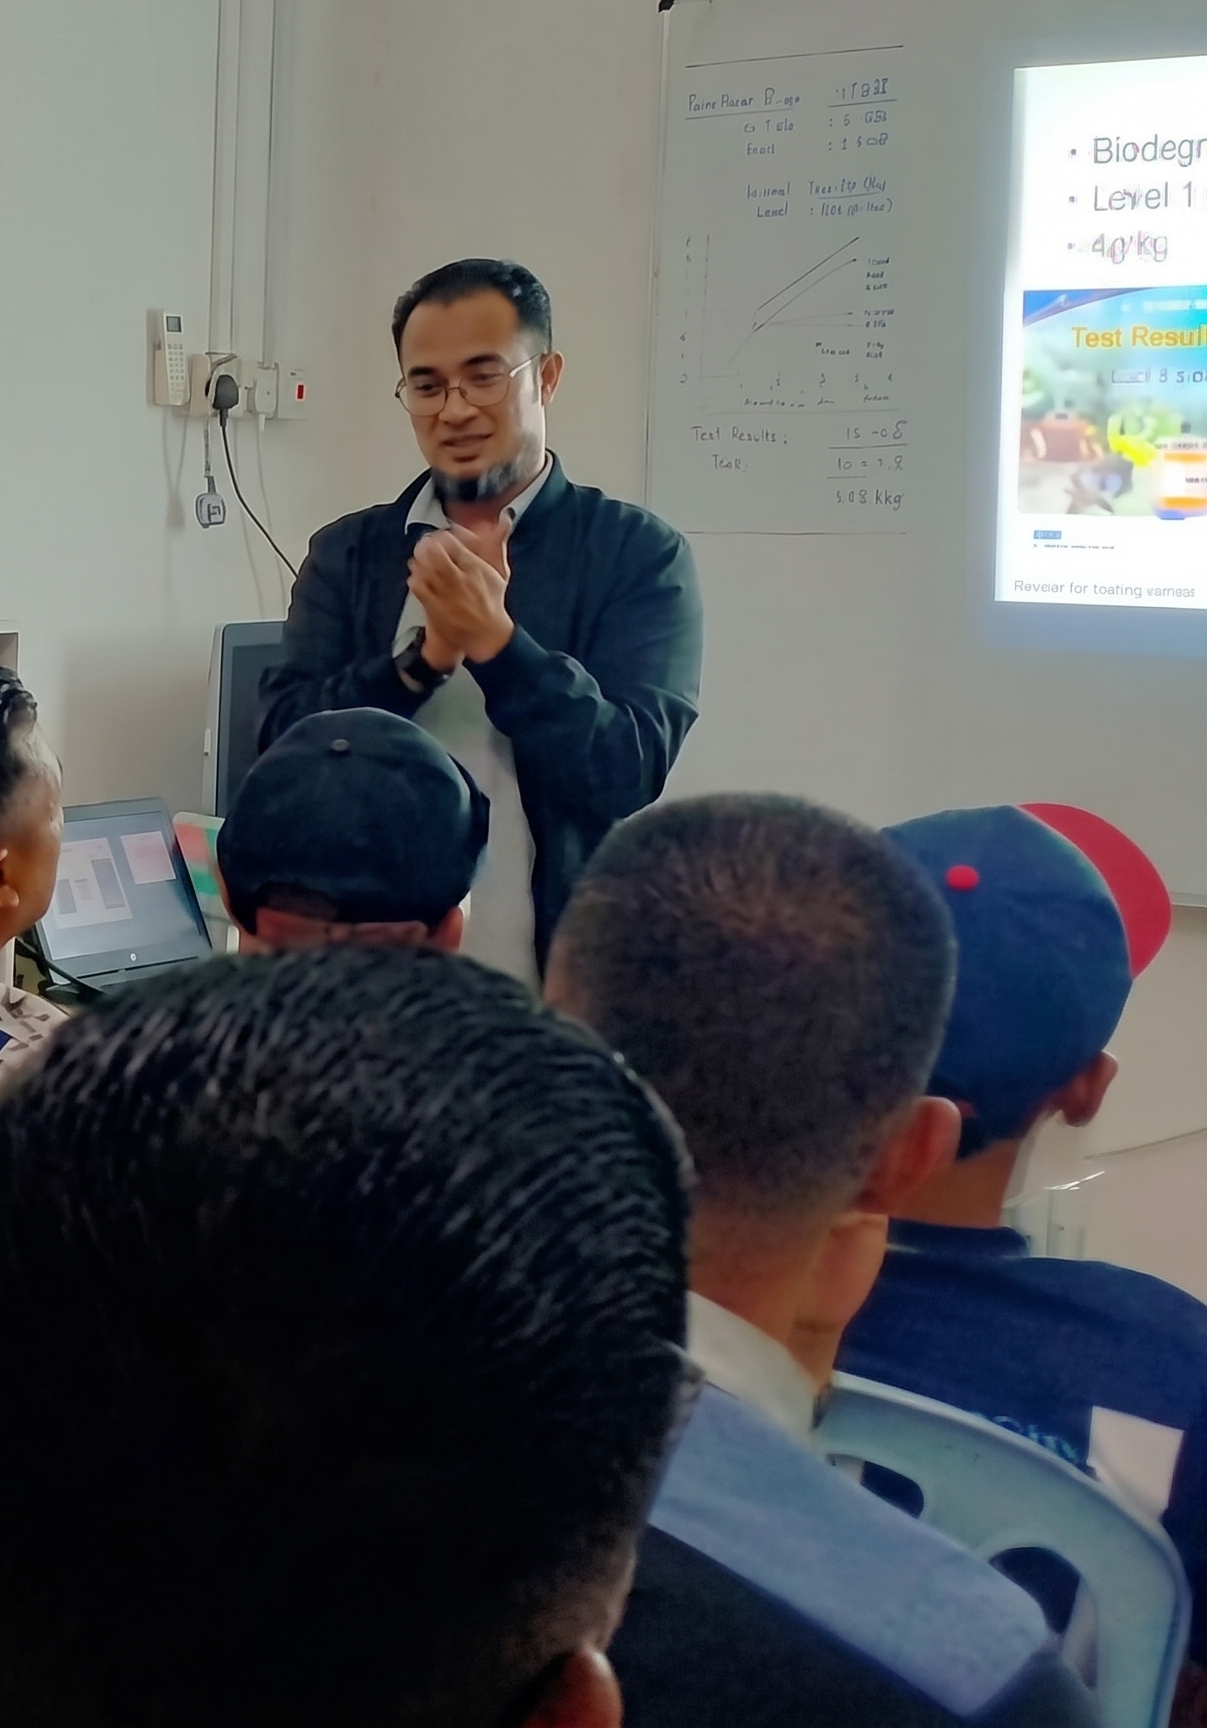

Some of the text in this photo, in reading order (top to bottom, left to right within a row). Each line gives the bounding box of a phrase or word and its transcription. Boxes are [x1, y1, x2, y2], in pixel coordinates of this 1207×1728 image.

[1071, 323, 1207, 348] Test Resul
[1069, 581, 1089, 594] for
